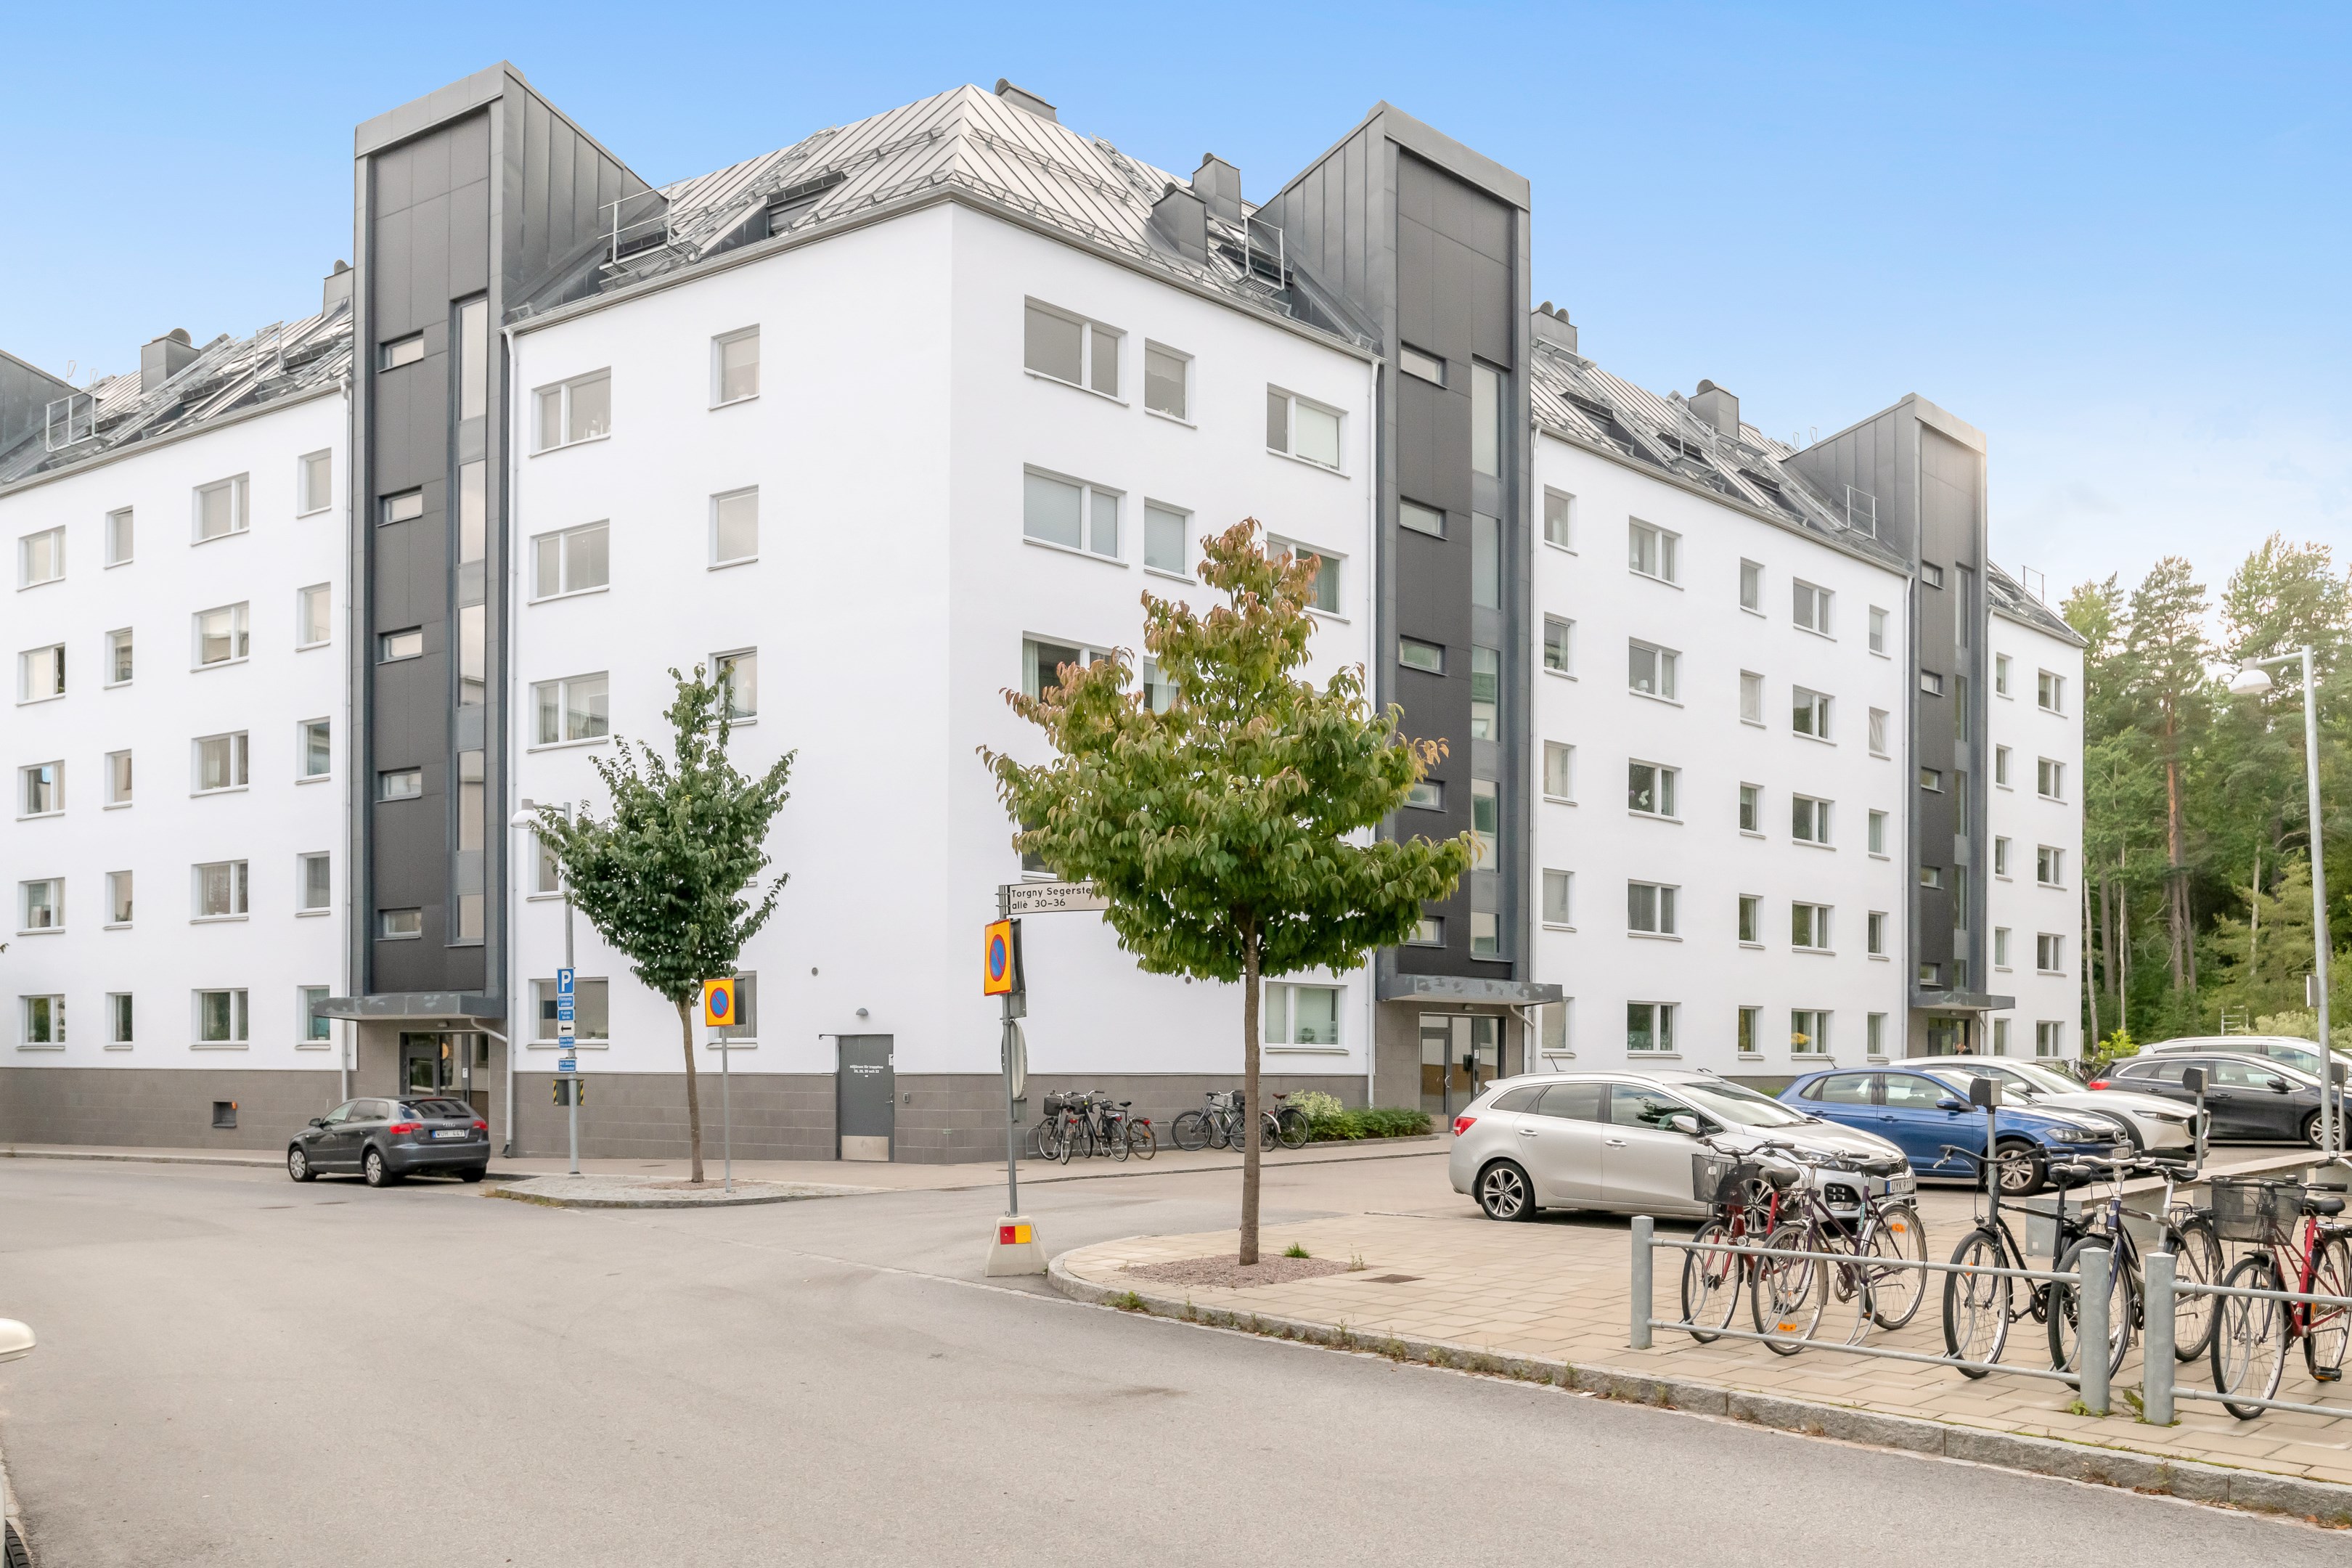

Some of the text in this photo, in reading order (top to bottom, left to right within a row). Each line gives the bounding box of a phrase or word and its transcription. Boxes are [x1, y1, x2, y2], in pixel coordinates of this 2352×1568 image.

[1011, 889, 1043, 898] Torgny
[561, 971, 571, 992] P
[1892, 1181, 1903, 1191] UYK
